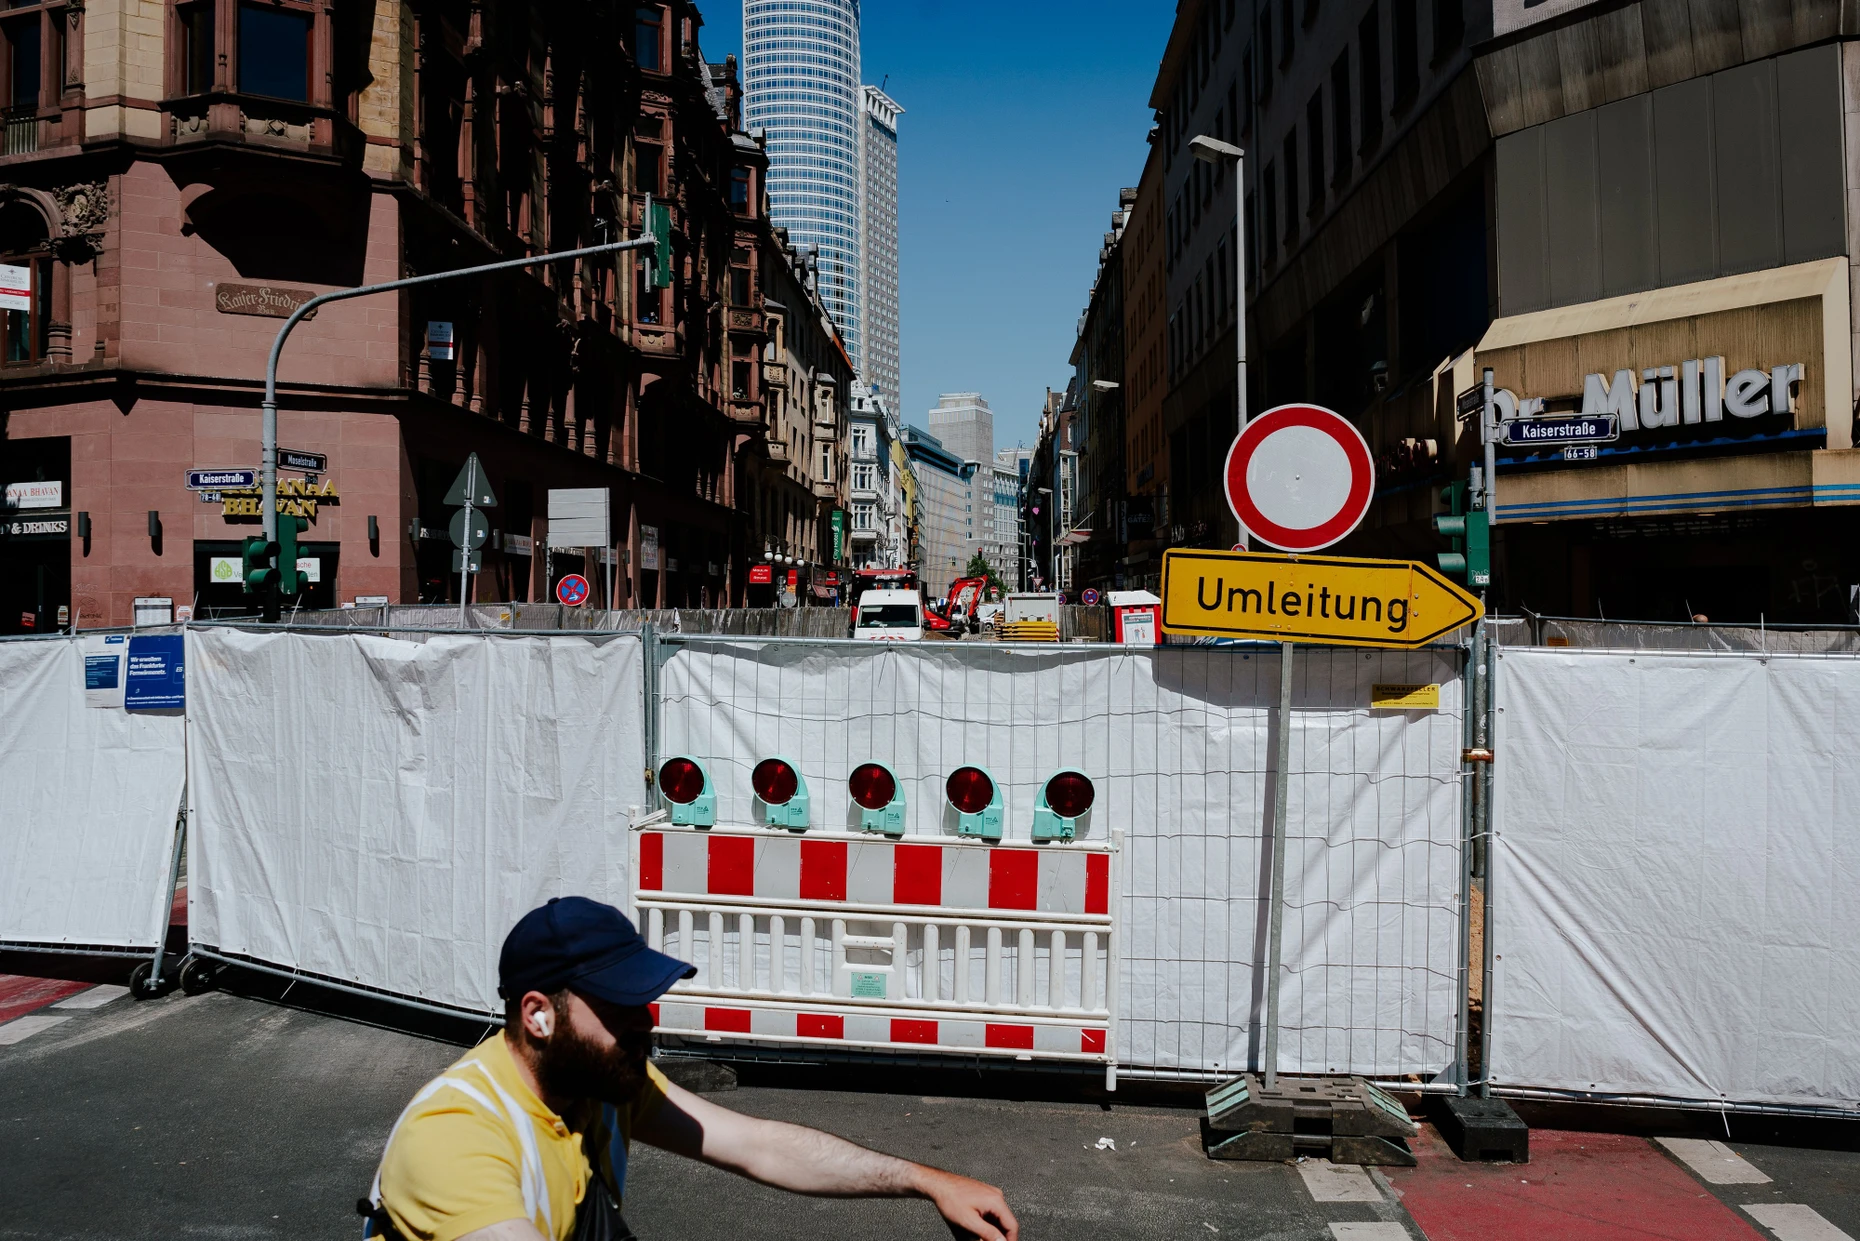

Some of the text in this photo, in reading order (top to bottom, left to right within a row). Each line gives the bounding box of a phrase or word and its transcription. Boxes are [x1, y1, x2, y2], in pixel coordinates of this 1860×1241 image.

[1581, 355, 1804, 432] Müller
[1522, 421, 1597, 439] Kaiserstraße
[287, 454, 318, 469] Moselstraße
[1566, 449, 1596, 460] 66-58
[199, 473, 245, 484] Kaiserstraße
[30, 487, 59, 497] BHAVAN
[22, 520, 68, 534] DRINKS
[1197, 576, 1409, 633] Umleitung
